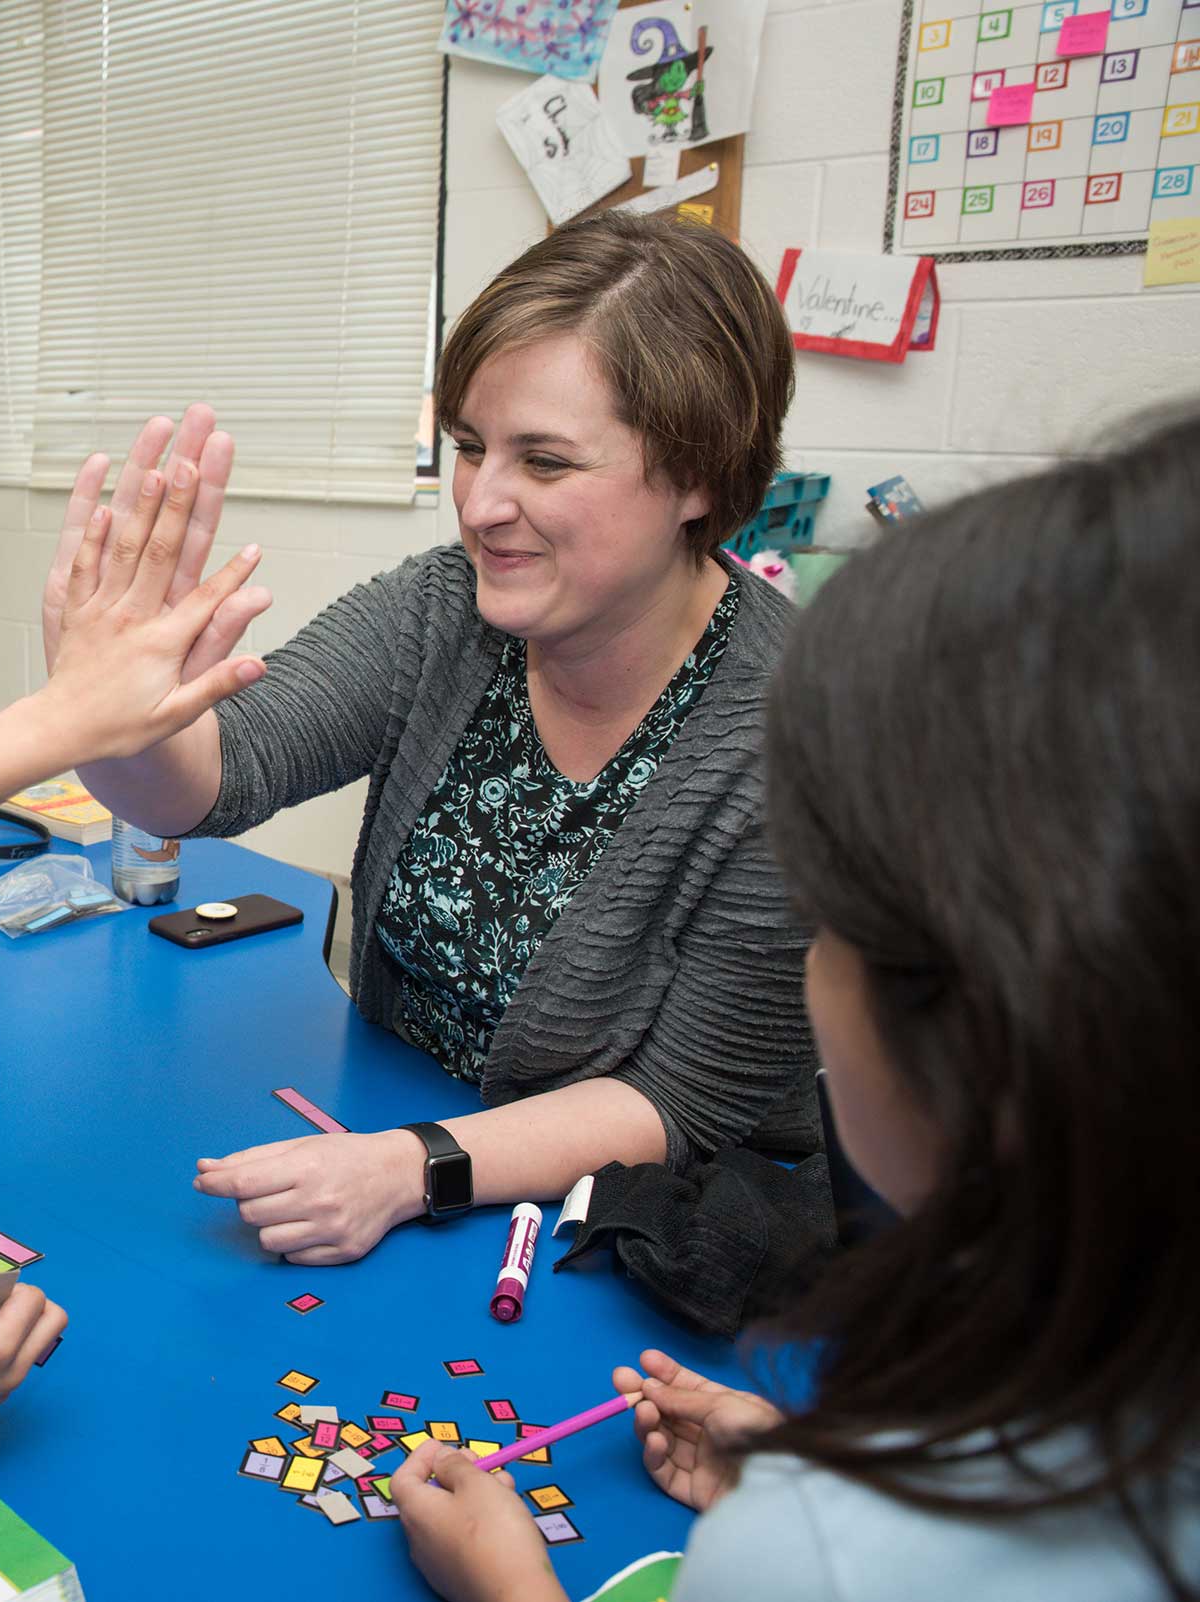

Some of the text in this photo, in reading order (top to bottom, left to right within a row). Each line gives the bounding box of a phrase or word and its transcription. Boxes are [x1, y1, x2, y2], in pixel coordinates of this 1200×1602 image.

[929, 30, 940, 42] 3
[988, 18, 1000, 32] 4
[1054, 7, 1065, 22] 5
[920, 86, 936, 99] 10
[1043, 68, 1059, 84] 12
[1111, 59, 1127, 75] 13
[917, 110, 1192, 157] 17 18 19 20 21
[910, 172, 1185, 212] 24 25 26 27 28
